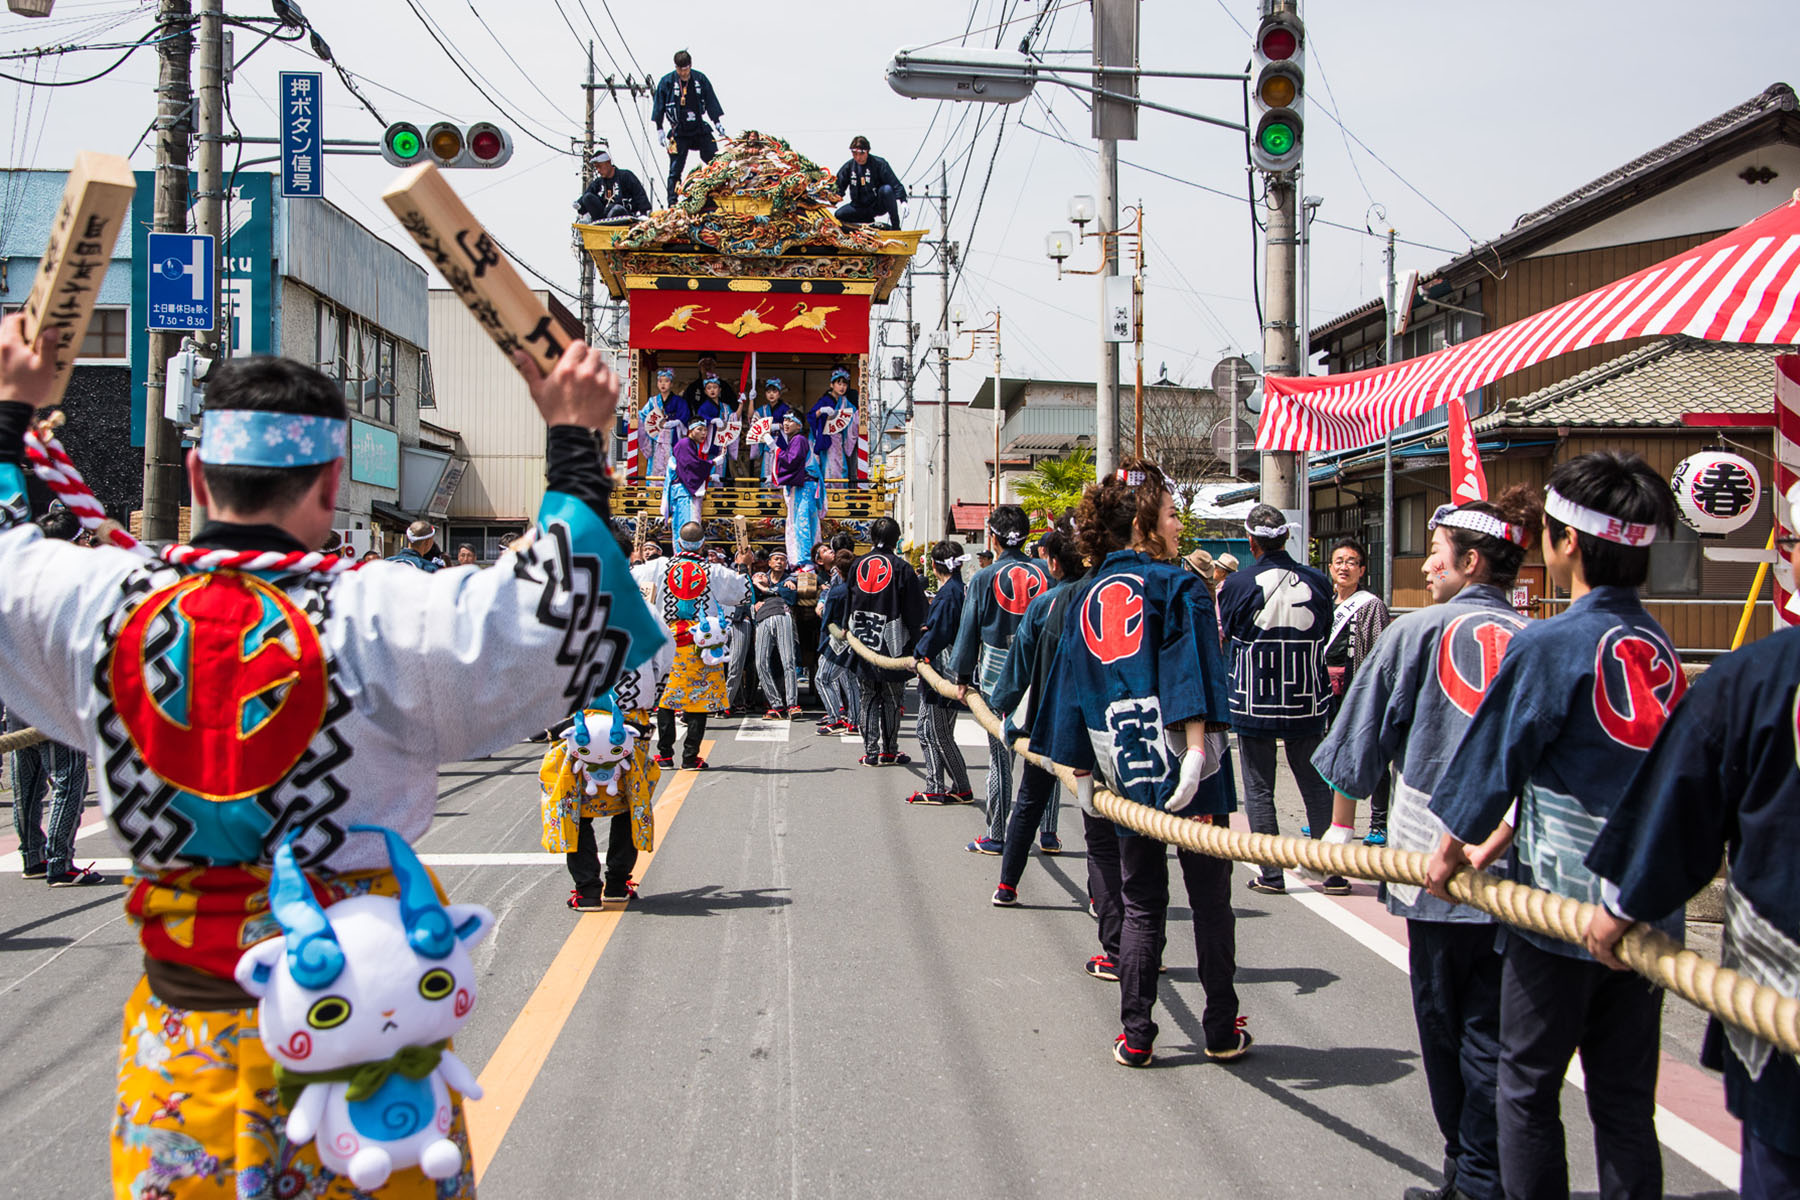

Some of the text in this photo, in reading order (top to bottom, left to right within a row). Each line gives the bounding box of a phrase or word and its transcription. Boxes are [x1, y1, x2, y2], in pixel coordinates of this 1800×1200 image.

[291, 78, 312, 191] 押ボタン信号
[222, 256, 252, 272] ku
[456, 229, 565, 361] 上町
[1694, 463, 1754, 516] 春
